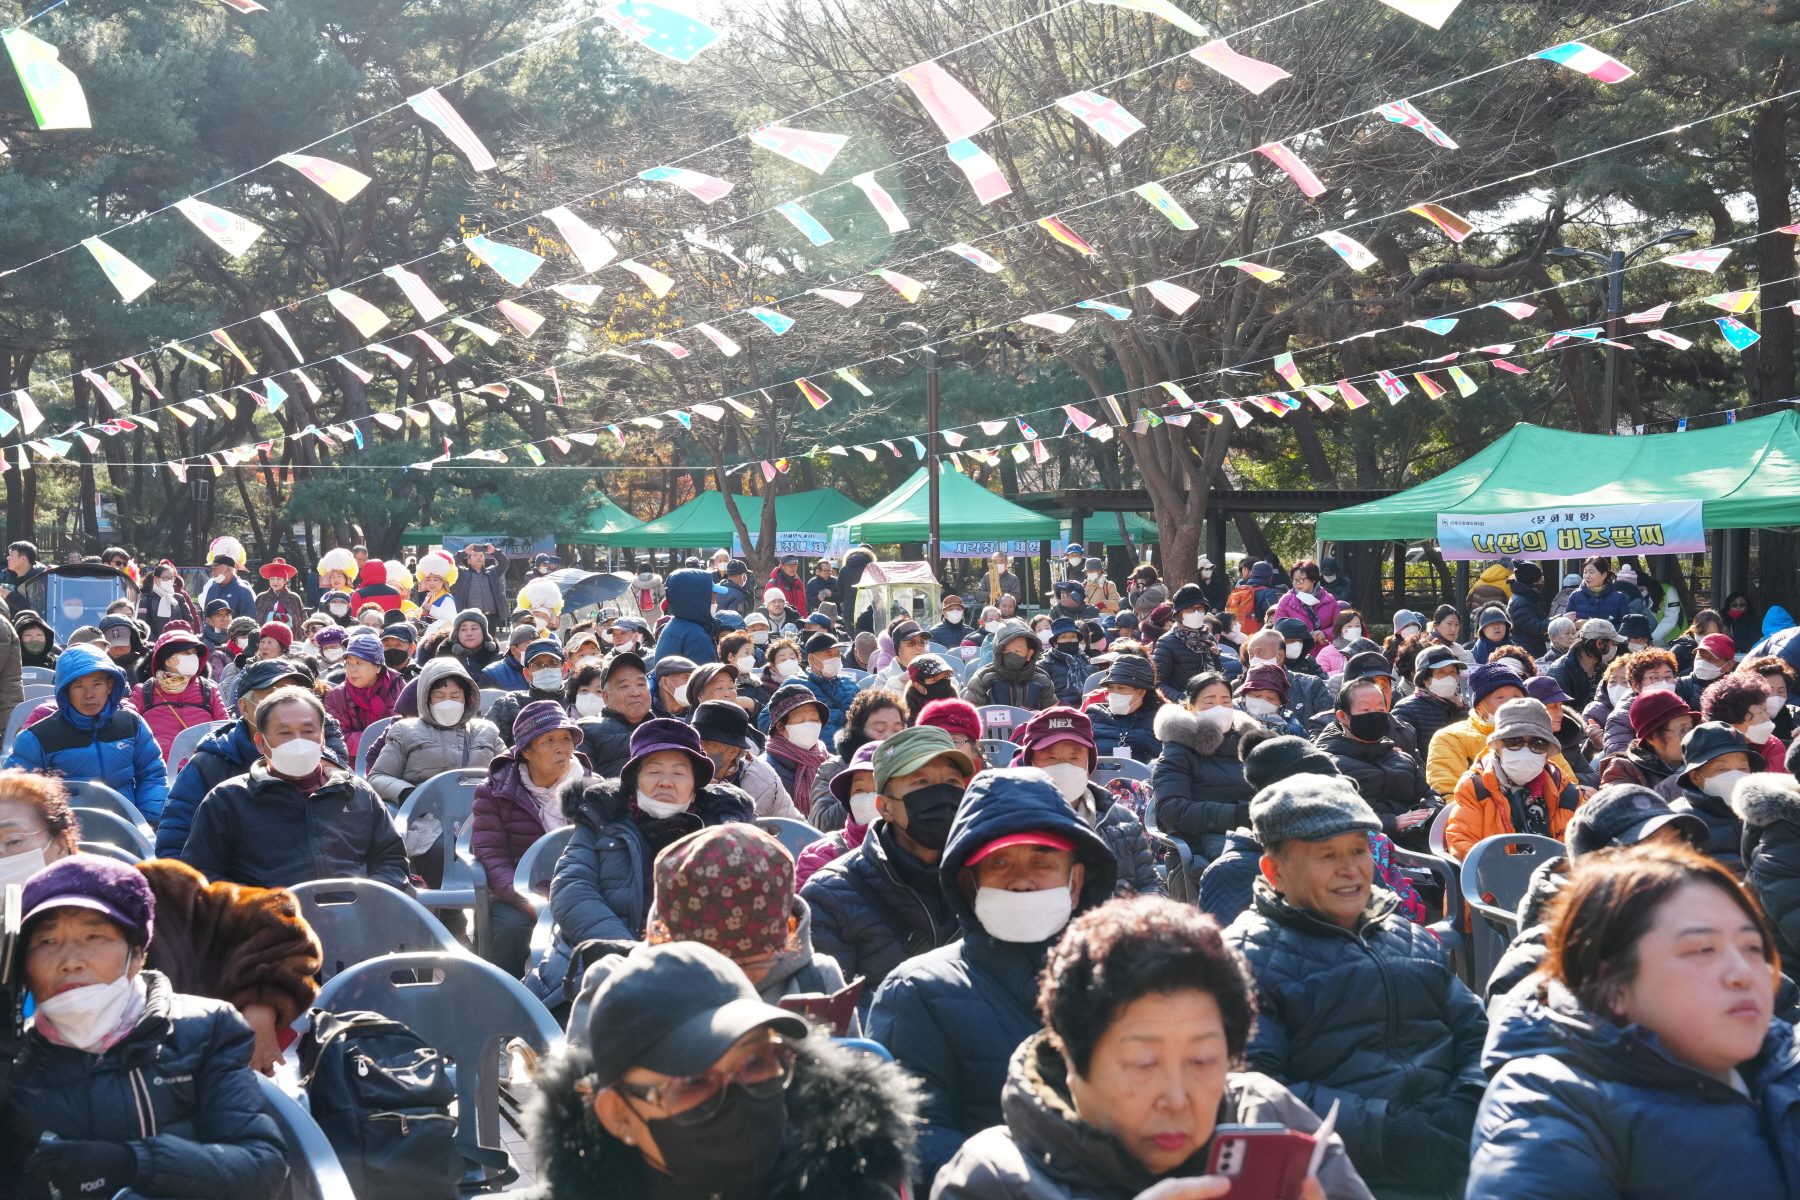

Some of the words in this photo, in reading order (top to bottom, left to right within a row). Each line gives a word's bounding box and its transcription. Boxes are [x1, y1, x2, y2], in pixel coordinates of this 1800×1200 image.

[954, 541, 1008, 554] 시각장애
[1472, 530, 1548, 554] 나만의
[1557, 524, 1665, 551] 비즈팔찌
